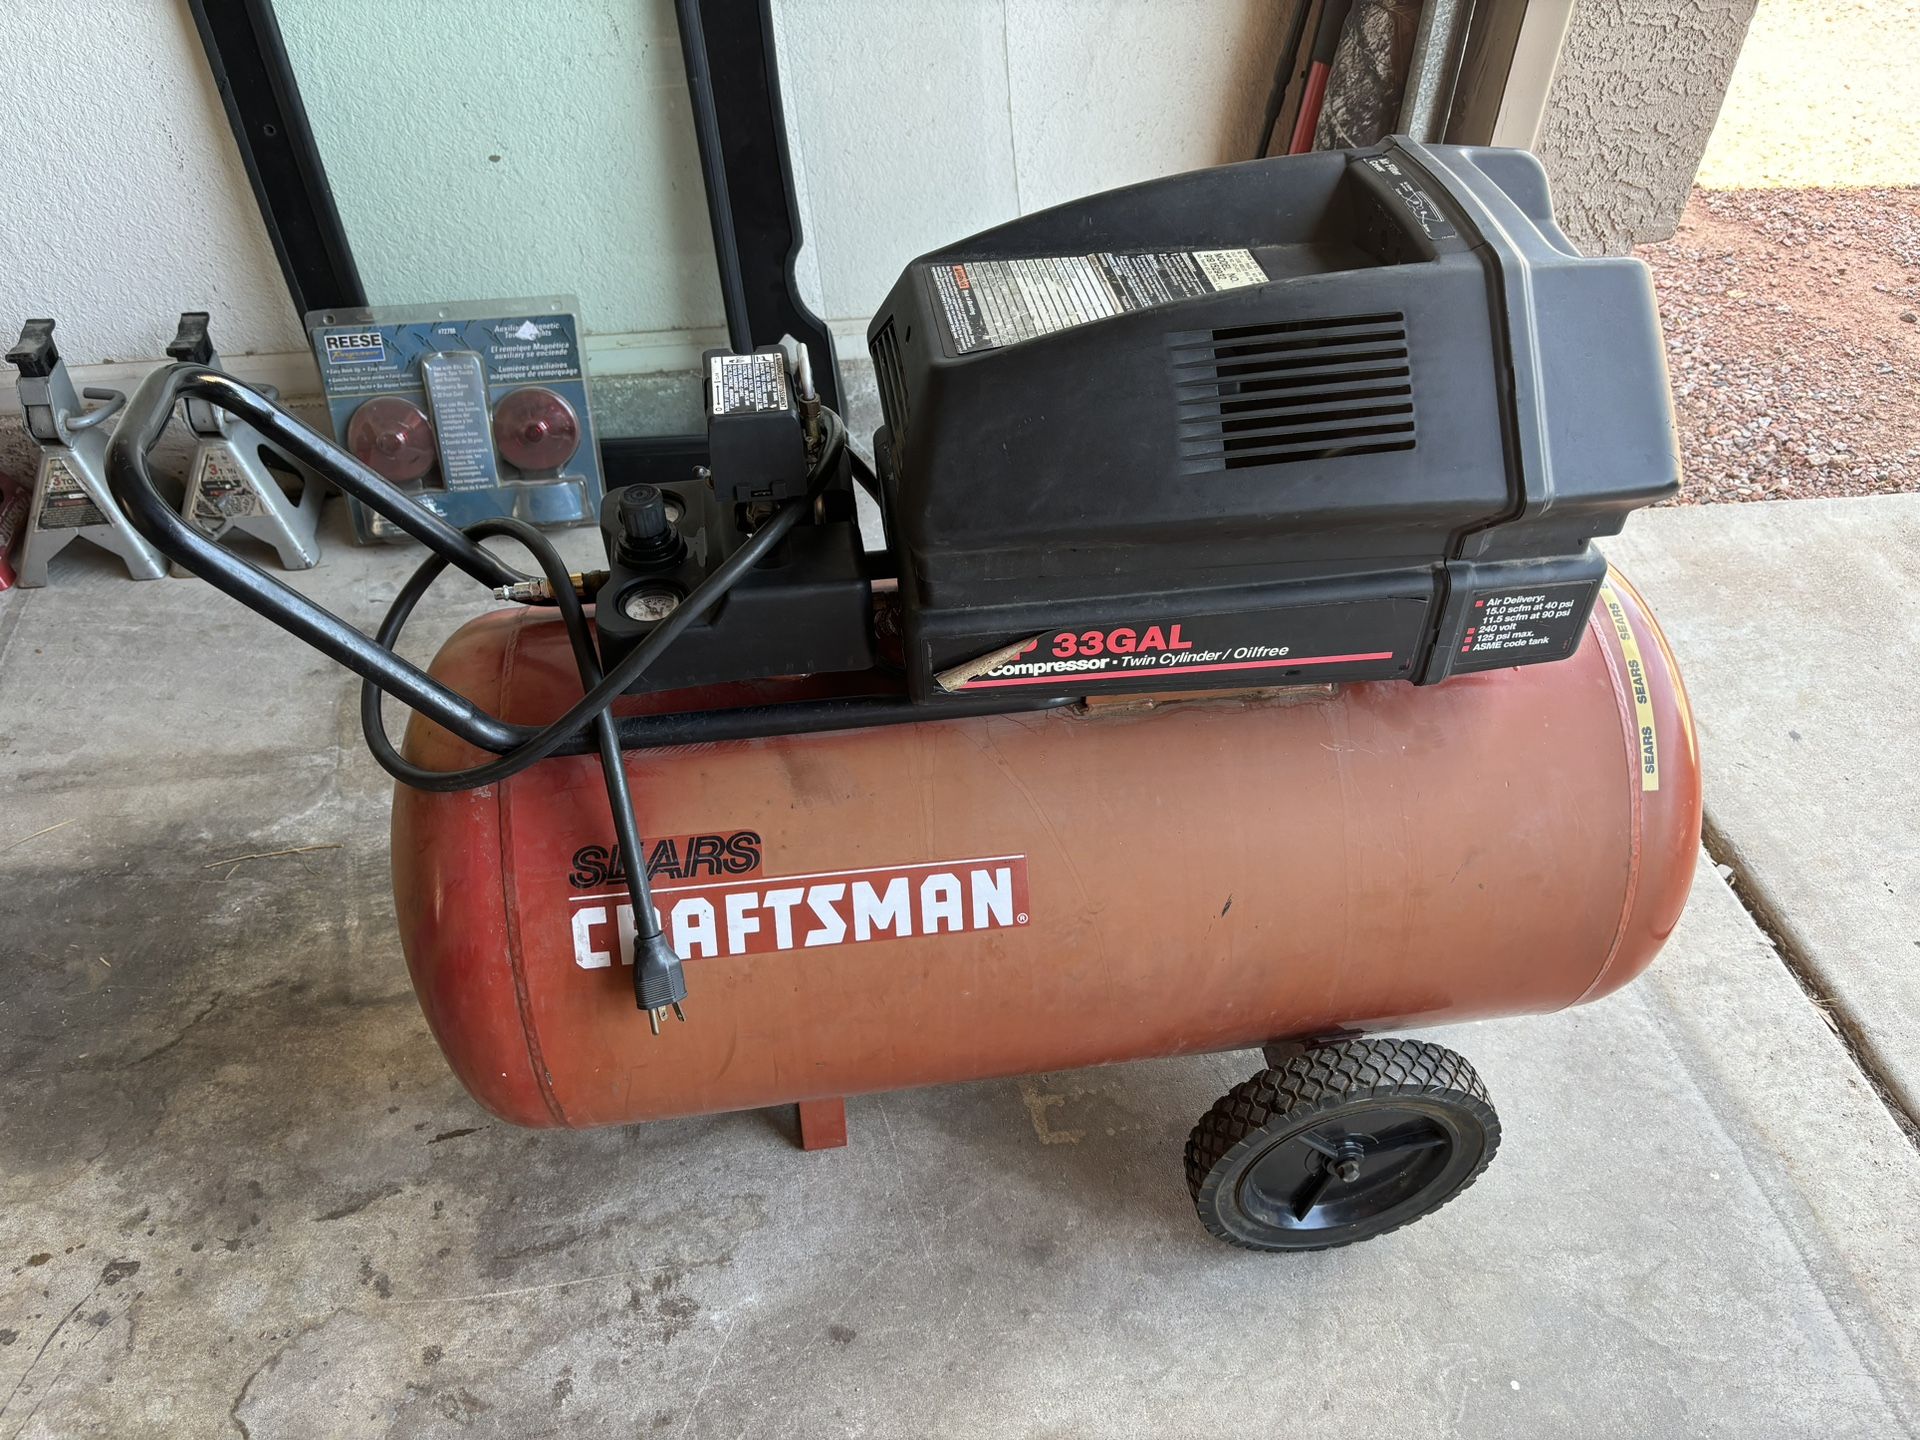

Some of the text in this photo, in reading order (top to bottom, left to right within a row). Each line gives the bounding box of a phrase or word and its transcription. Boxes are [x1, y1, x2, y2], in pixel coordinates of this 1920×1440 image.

[326, 334, 382, 350] REESE
[208, 464, 218, 476] 3
[52, 475, 62, 486] 3
[1486, 606, 1506, 615] 15.0
[1507, 604, 1531, 613] scfm
[1533, 603, 1543, 611] at
[1558, 600, 1574, 609] psi
[1487, 595, 1546, 607] Air Delivery:
[1483, 609, 1571, 625] 11.5 scfm at 90 psi
[1609, 602, 1631, 641] SEARS
[1478, 622, 1517, 634] 240 volt
[1052, 624, 1192, 658] 33GAL
[1473, 641, 1502, 651] ASME
[1503, 639, 1527, 648] code
[1529, 637, 1550, 645] tank
[1477, 634, 1495, 642] 125
[1496, 632, 1511, 641] psi
[1121, 654, 1156, 667] Twin
[1159, 650, 1222, 666] Cylinder
[1233, 646, 1289, 659] Oilfree
[1628, 659, 1648, 705] SEARS
[1641, 726, 1656, 774] SEARS
